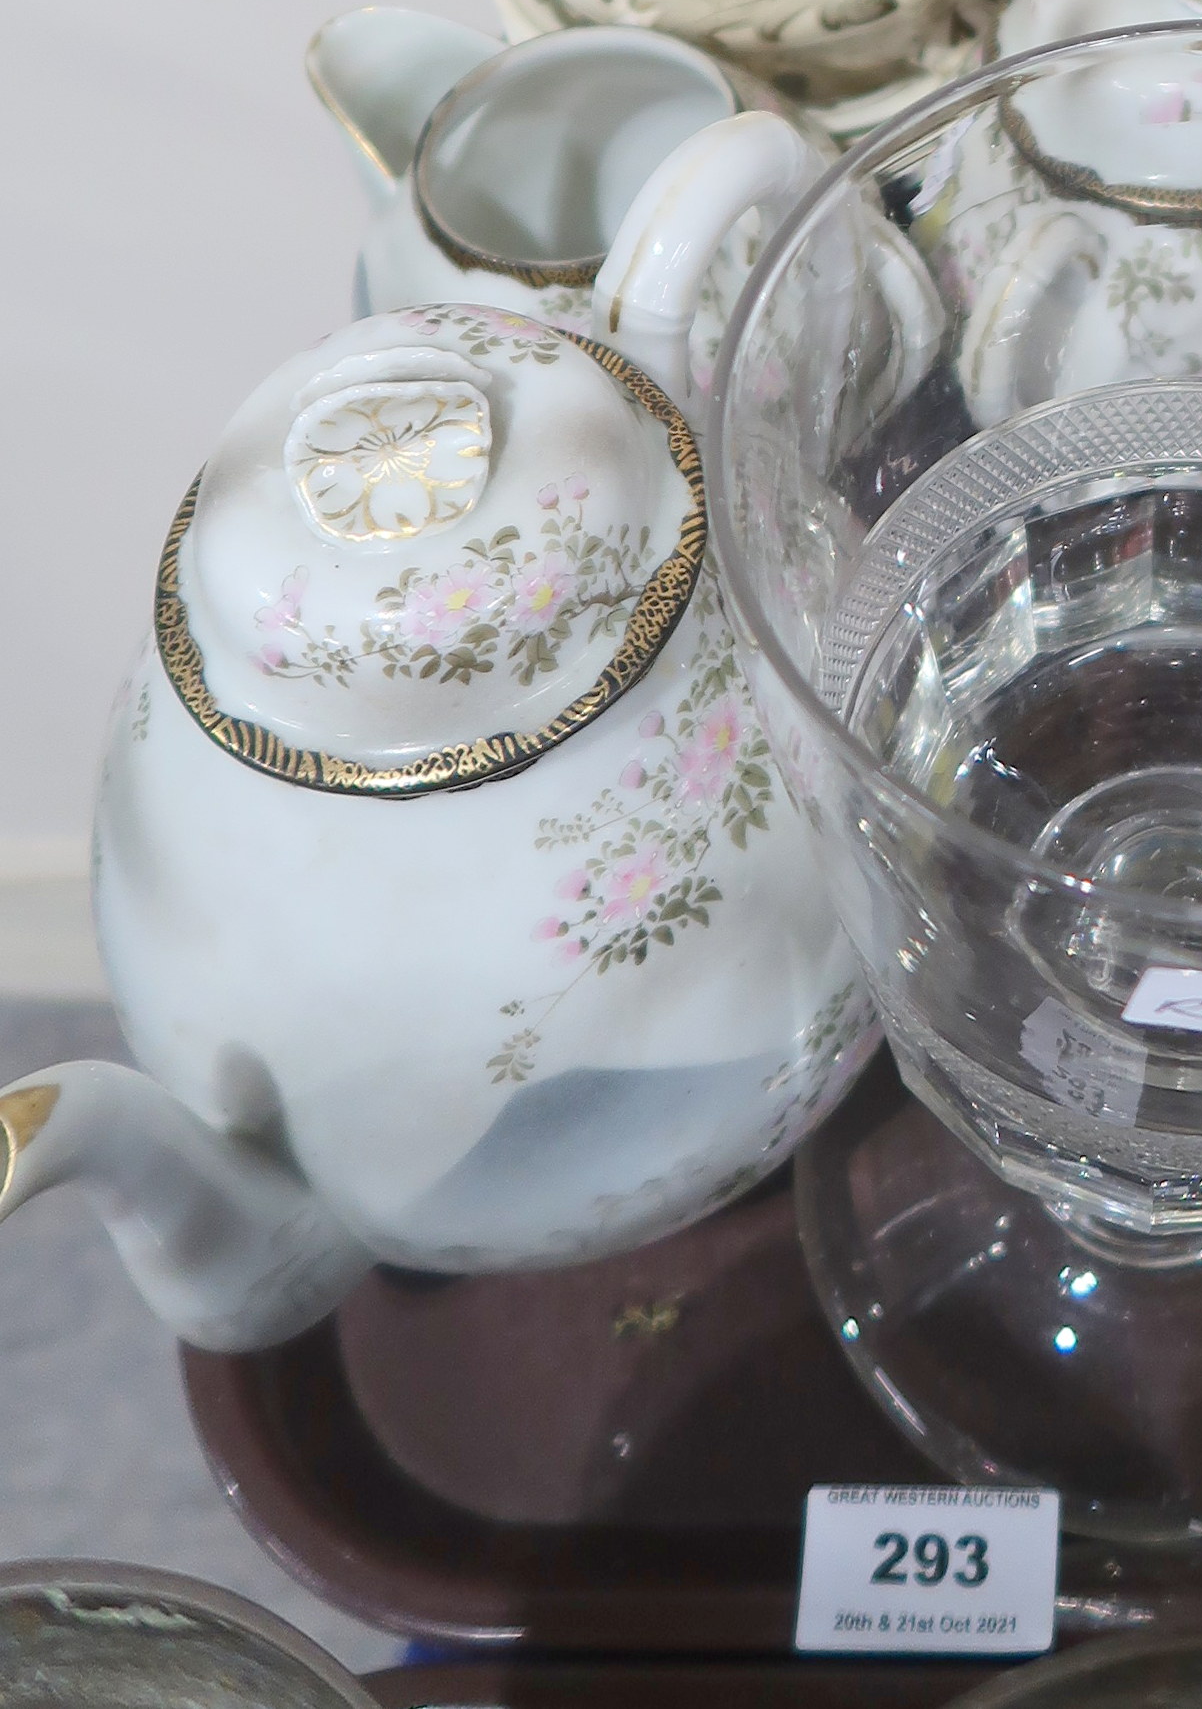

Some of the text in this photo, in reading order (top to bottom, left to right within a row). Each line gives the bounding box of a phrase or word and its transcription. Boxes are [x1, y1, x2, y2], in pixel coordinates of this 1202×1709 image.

[827, 1488, 1040, 1509] GREAT WESTERN AUCTIONS
[870, 1531, 989, 1588] 293
[834, 1612, 1017, 1634] 20th & 21st Oct 2021
